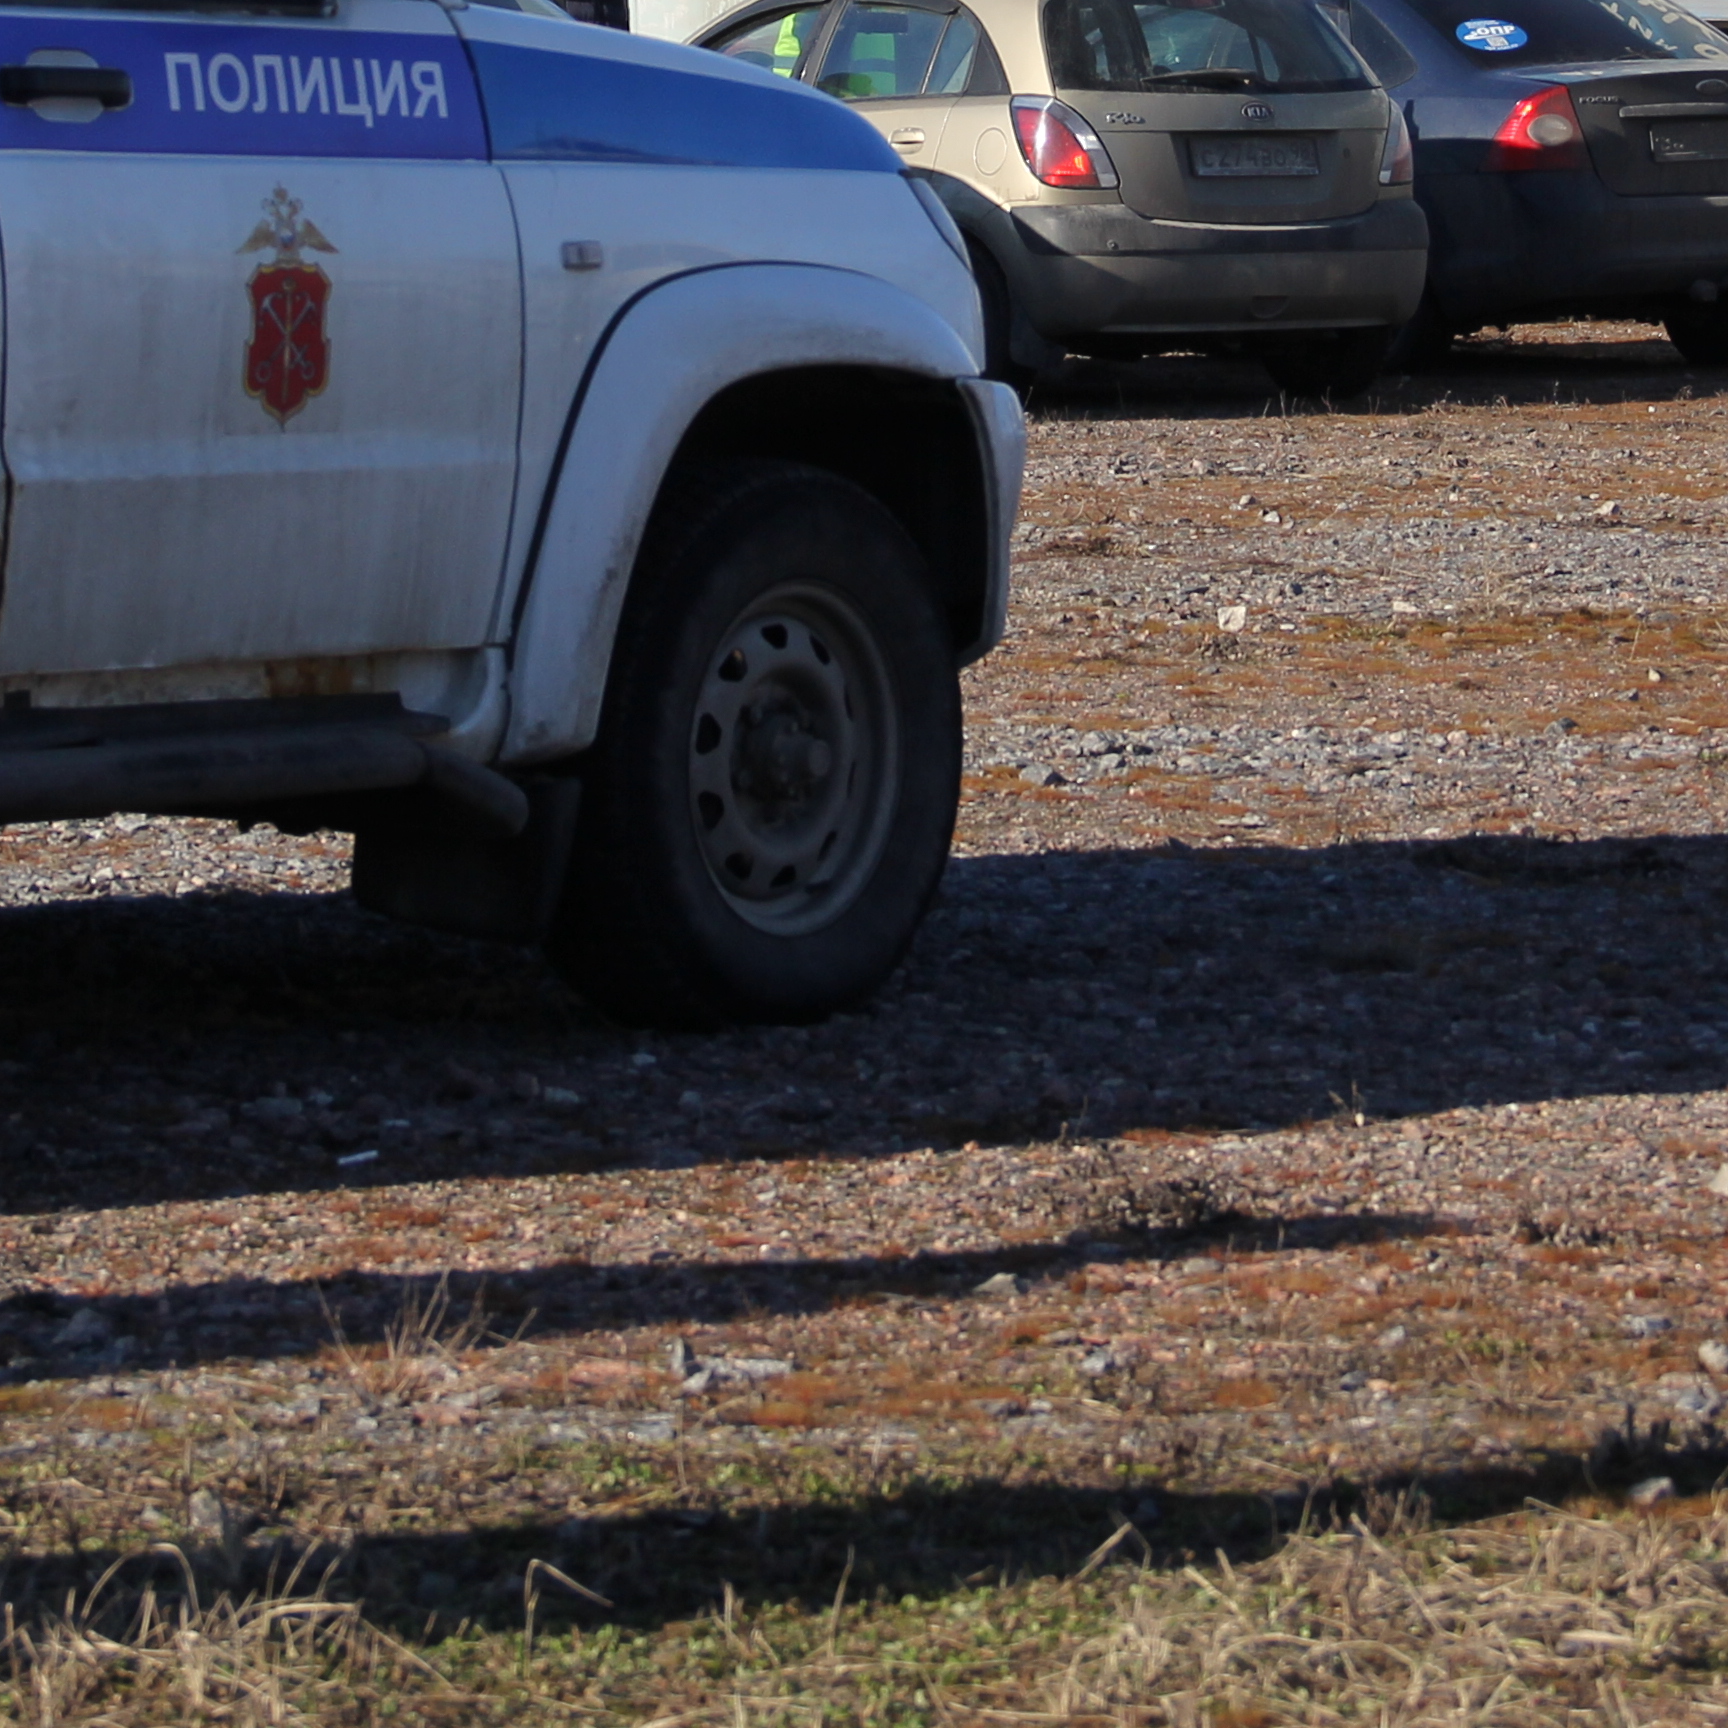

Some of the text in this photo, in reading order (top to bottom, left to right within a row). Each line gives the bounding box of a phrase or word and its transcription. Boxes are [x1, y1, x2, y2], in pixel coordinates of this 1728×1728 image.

[1476, 25, 1515, 35] ОПР
[163, 51, 450, 128] ПОЛИЦИЯ
[1578, 95, 1619, 104] FOCUS
[1247, 106, 1270, 117] KIA
